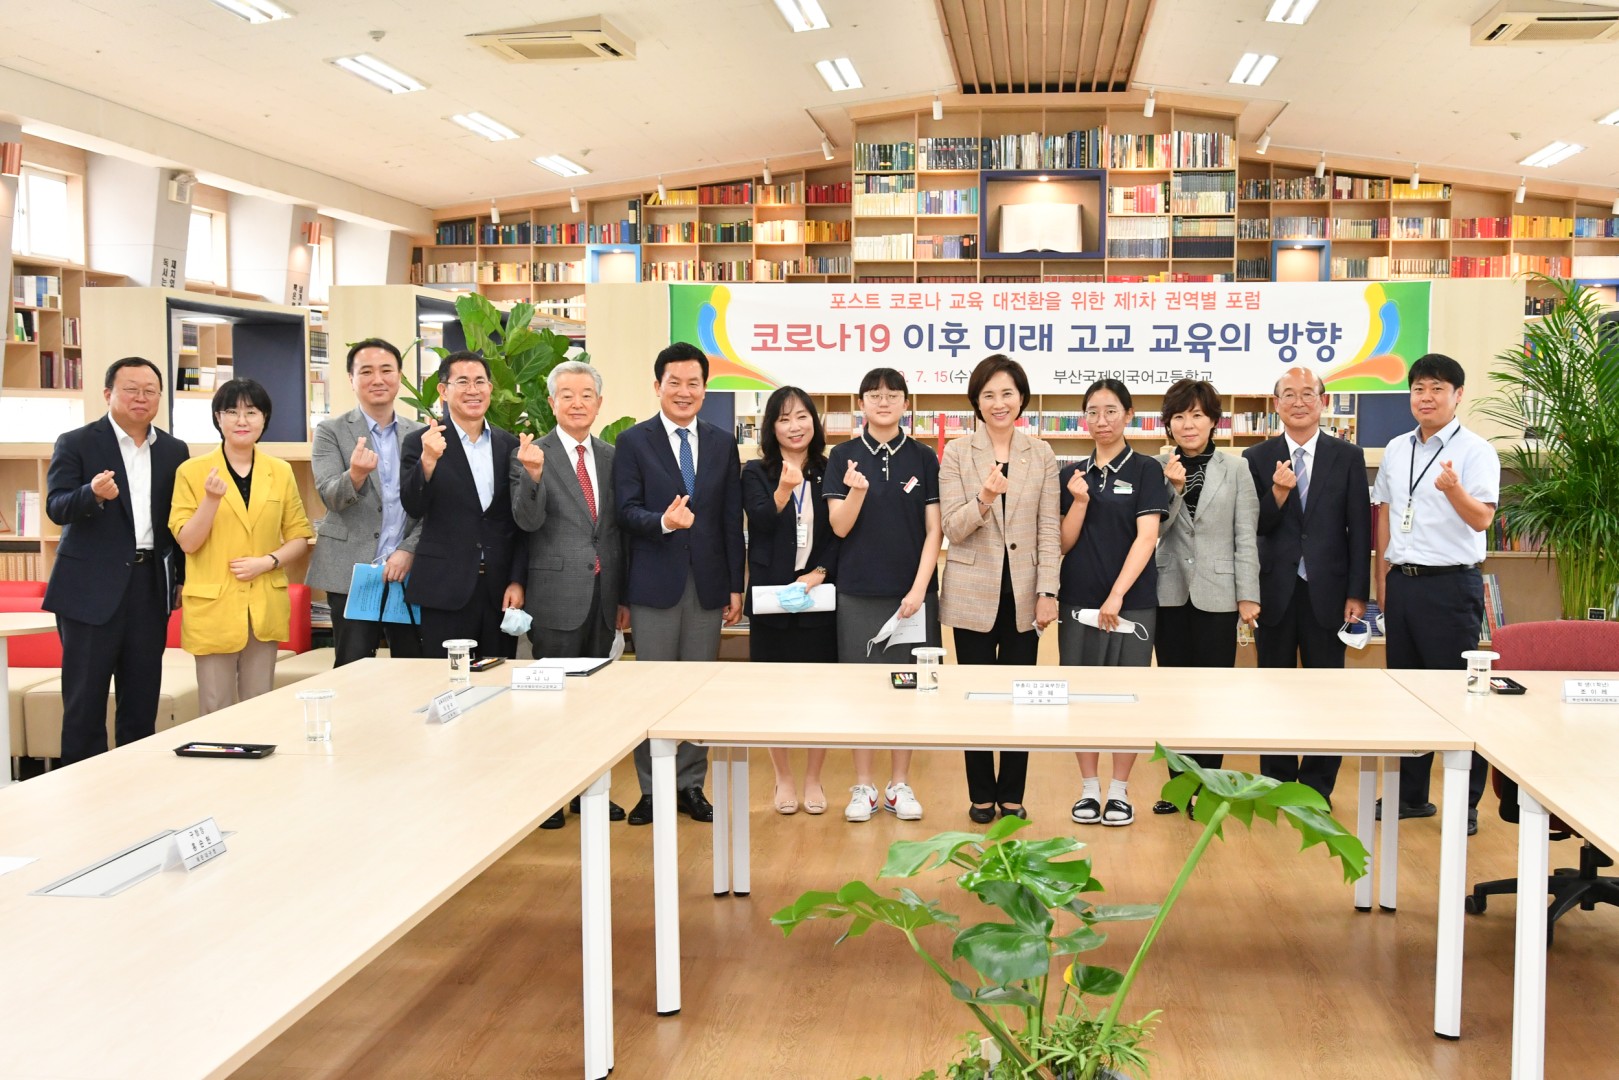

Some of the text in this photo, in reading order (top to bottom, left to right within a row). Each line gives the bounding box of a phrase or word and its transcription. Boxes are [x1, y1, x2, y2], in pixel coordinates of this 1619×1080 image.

[830, 291, 1261, 311] 포스트 코로나 교육 대전환을 위한 제1차 권역별 포럼
[750, 321, 1343, 363] 코로나19 이후 미래 고교 교육의 방향
[915, 370, 927, 383] 7.
[1053, 369, 1214, 385] 부산국제외국어고등학교
